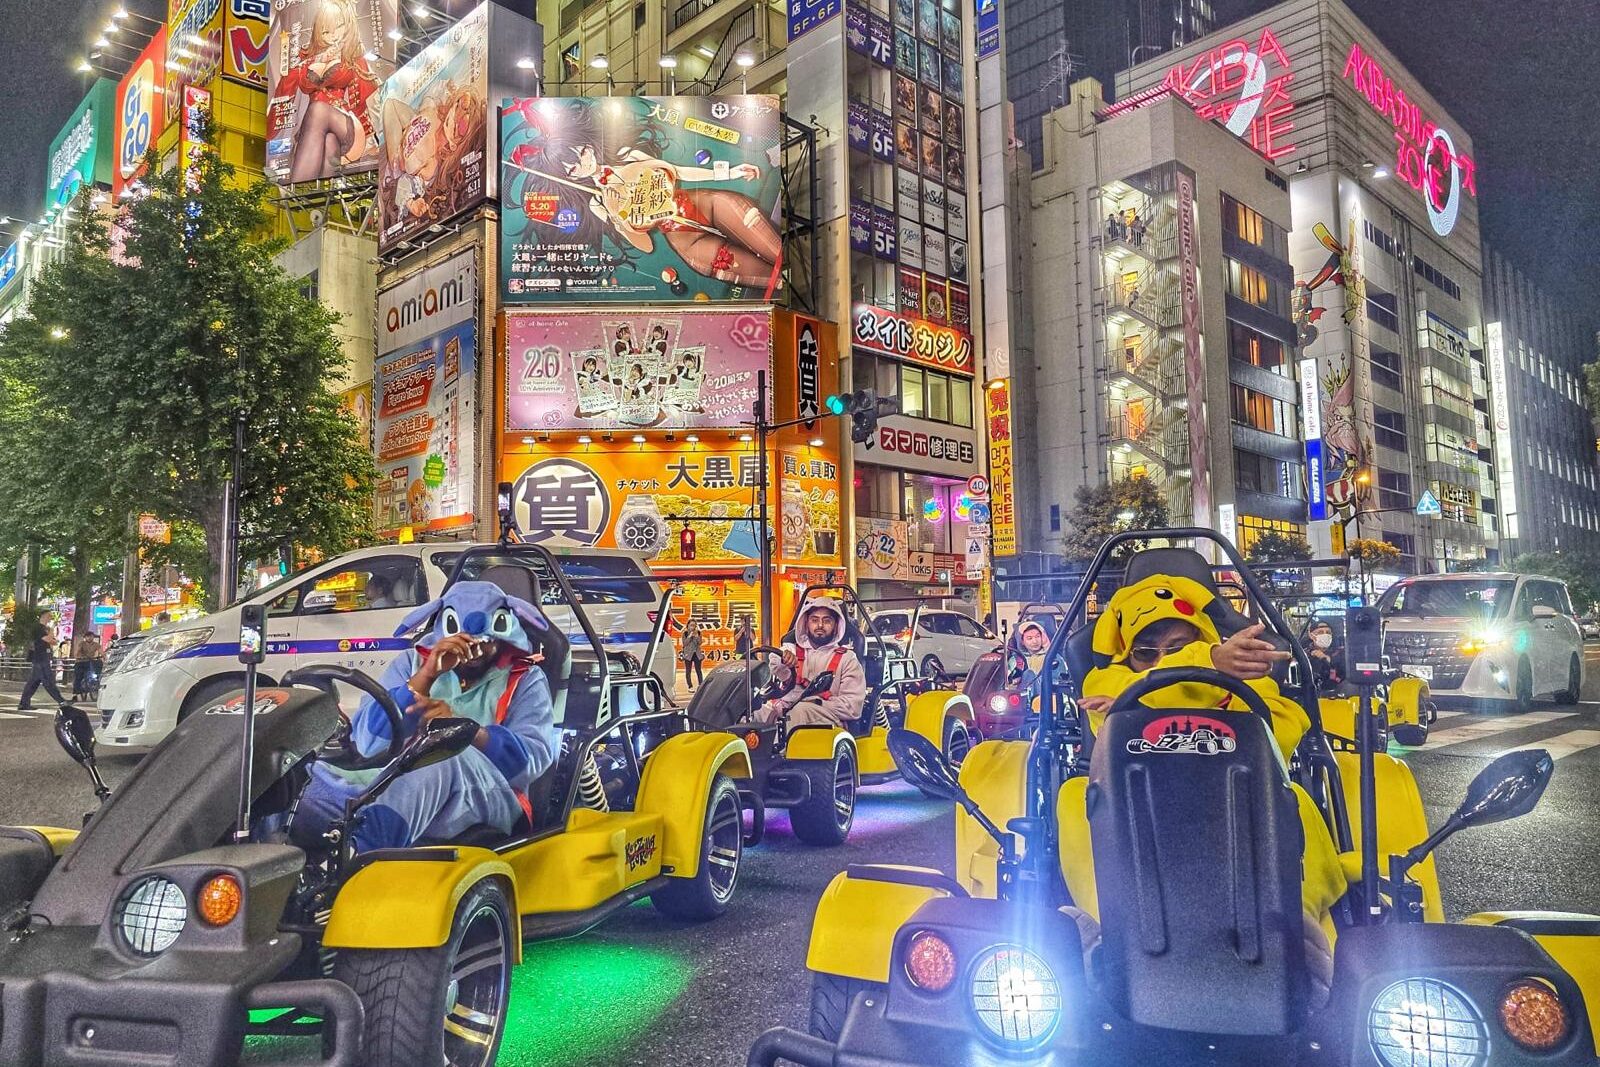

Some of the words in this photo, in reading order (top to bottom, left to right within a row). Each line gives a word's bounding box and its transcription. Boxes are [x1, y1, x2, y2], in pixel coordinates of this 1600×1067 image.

[871, 36, 891, 63] 7F
[872, 132, 893, 156] 6F
[530, 202, 550, 210] 5.20
[558, 213, 577, 221] 6.11
[874, 230, 895, 254] 5F
[387, 275, 463, 332] amiami
[856, 310, 970, 367] メイドカジノ
[524, 347, 561, 379] 20
[881, 427, 973, 463] スマホ修理王
[616, 478, 660, 490] チケット
[667, 455, 771, 490] 大黒屋
[1002, 446, 1011, 478] TAX
[972, 480, 984, 490] 40
[521, 472, 600, 546] 質
[1004, 482, 1013, 524] FREE
